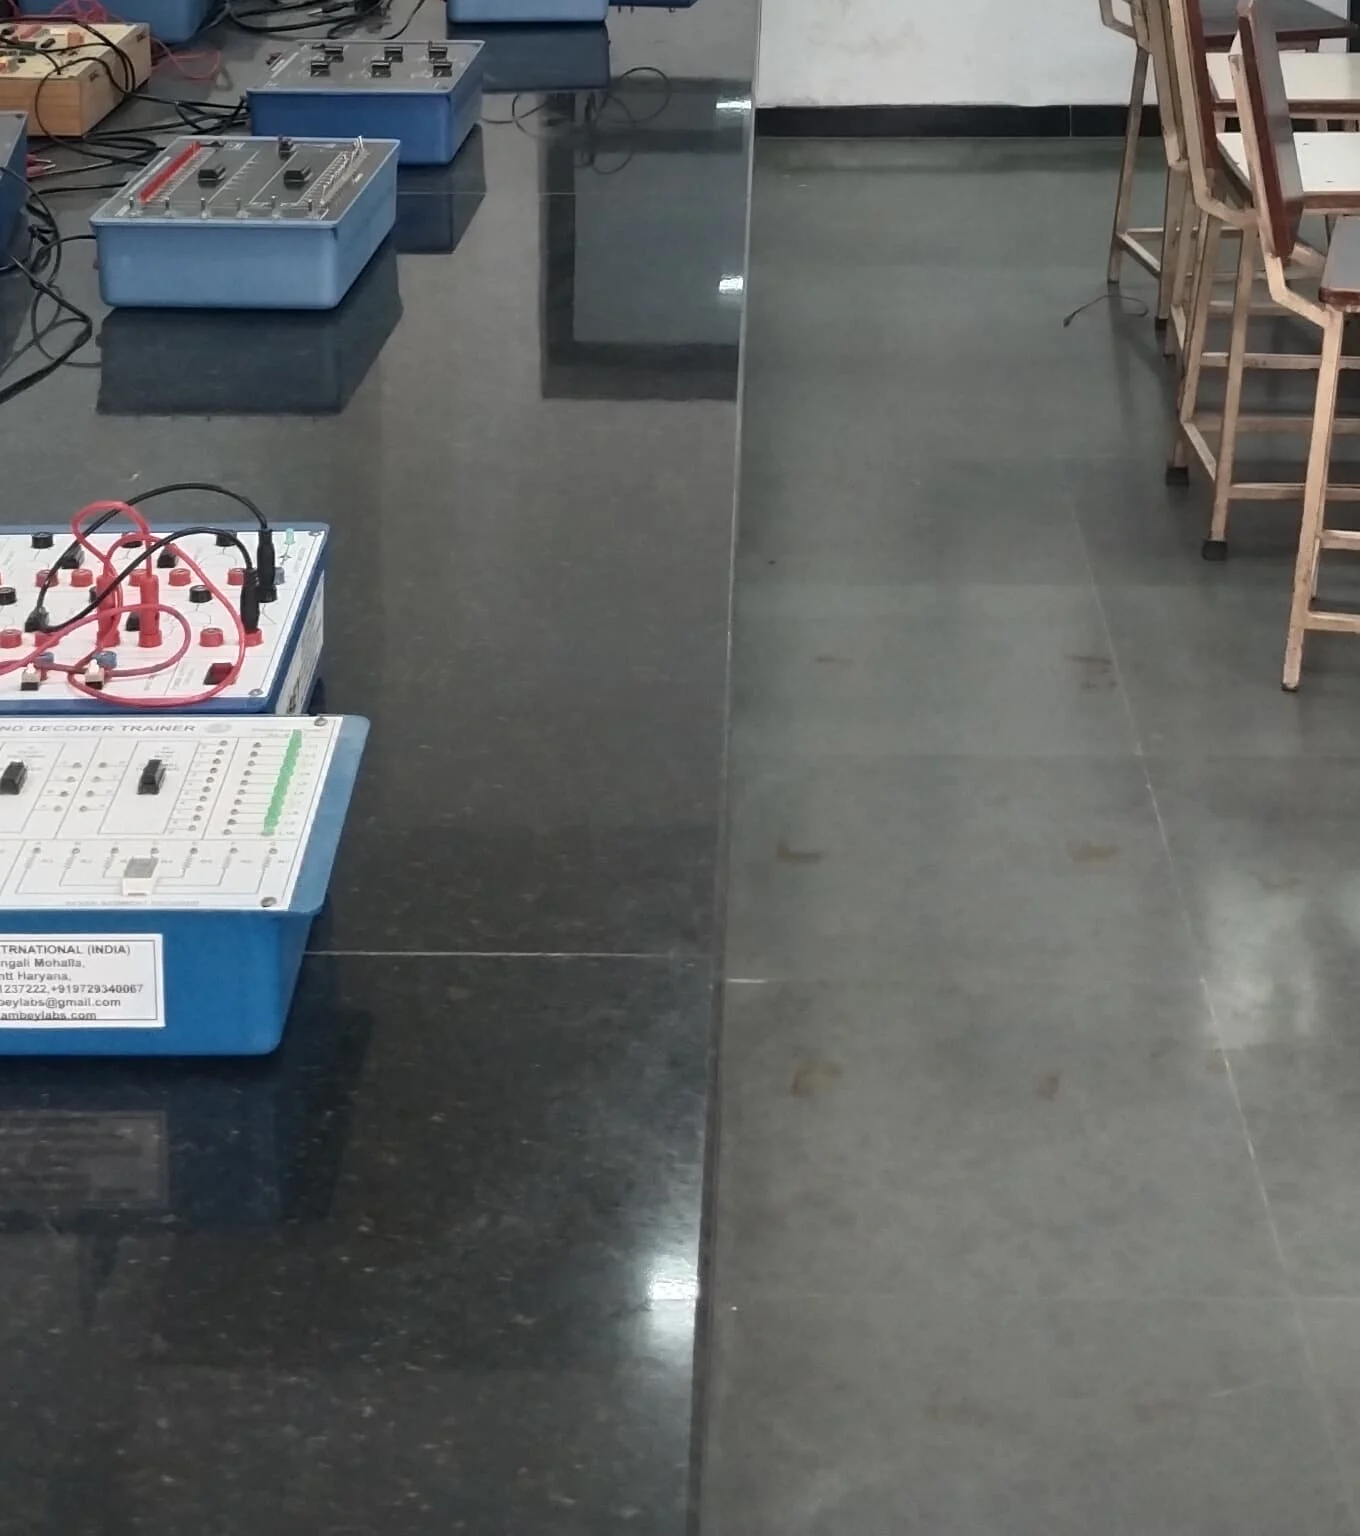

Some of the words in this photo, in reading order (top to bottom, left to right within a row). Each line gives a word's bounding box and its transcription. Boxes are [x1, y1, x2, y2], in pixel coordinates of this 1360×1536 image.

[28, 724, 115, 733] DECODER
[120, 724, 197, 733] TRAINER
[87, 944, 131, 956] (INDIA)
